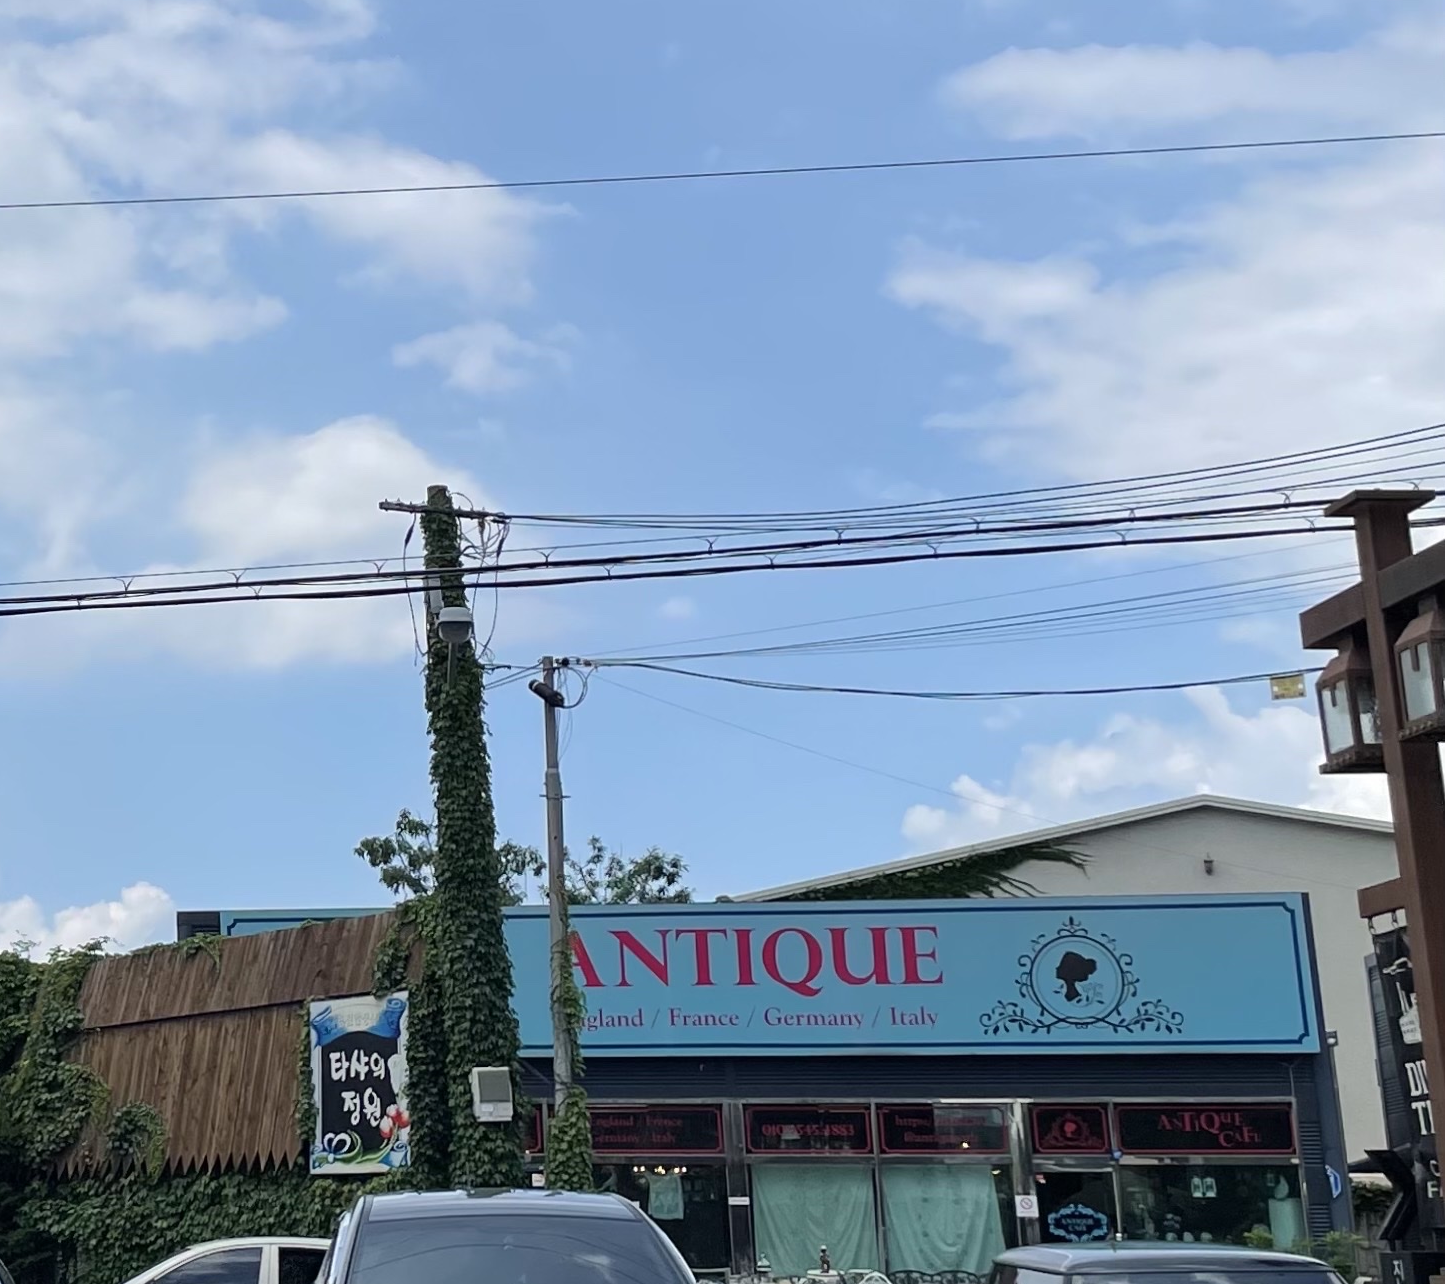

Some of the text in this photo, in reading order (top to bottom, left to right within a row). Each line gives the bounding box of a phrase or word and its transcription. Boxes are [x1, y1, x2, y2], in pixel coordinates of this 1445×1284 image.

[567, 926, 944, 997] ANTIQUE
[580, 1008, 644, 1032] gland
[668, 1007, 740, 1028] France
[763, 1006, 864, 1029] Germany
[889, 1005, 939, 1029] Italy
[329, 1049, 386, 1082] 타샤의
[341, 1087, 382, 1127] 정원
